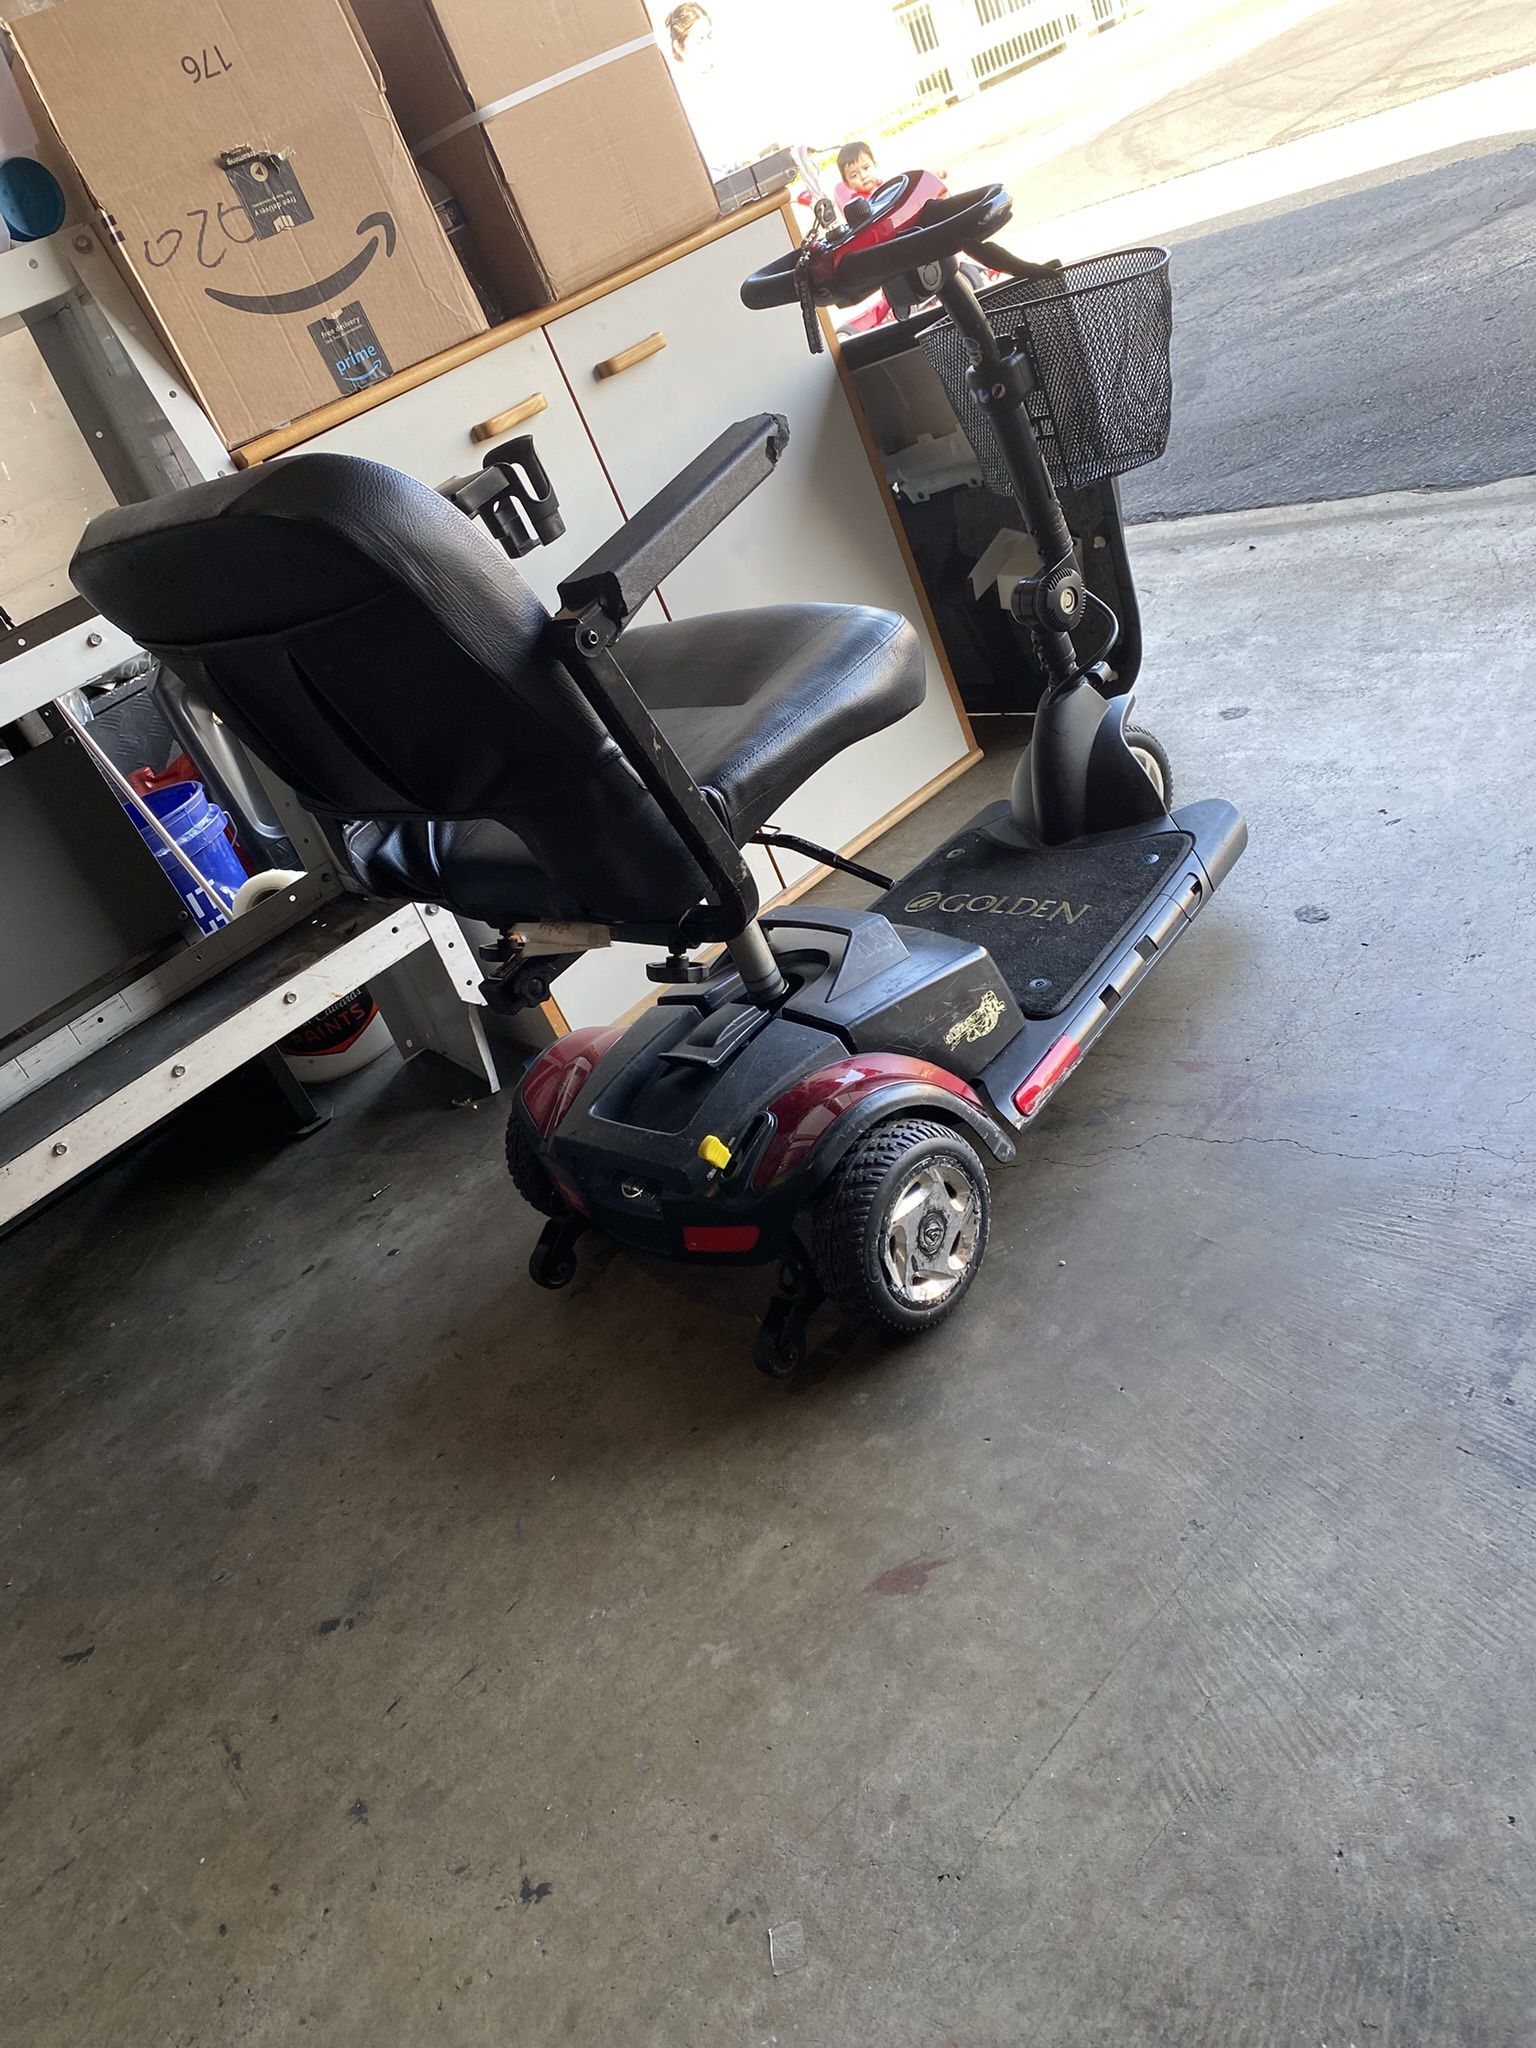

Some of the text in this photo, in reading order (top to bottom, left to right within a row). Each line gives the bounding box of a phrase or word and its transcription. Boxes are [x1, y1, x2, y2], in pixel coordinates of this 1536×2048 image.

[181, 44, 233, 84] 176
[254, 201, 281, 217] delivery
[281, 195, 298, 208] free
[320, 326, 335, 339] free
[335, 316, 361, 333] delivery
[335, 344, 377, 374] prime
[939, 892, 1092, 925] GOLDEN
[290, 1001, 366, 1045] PAINTS
